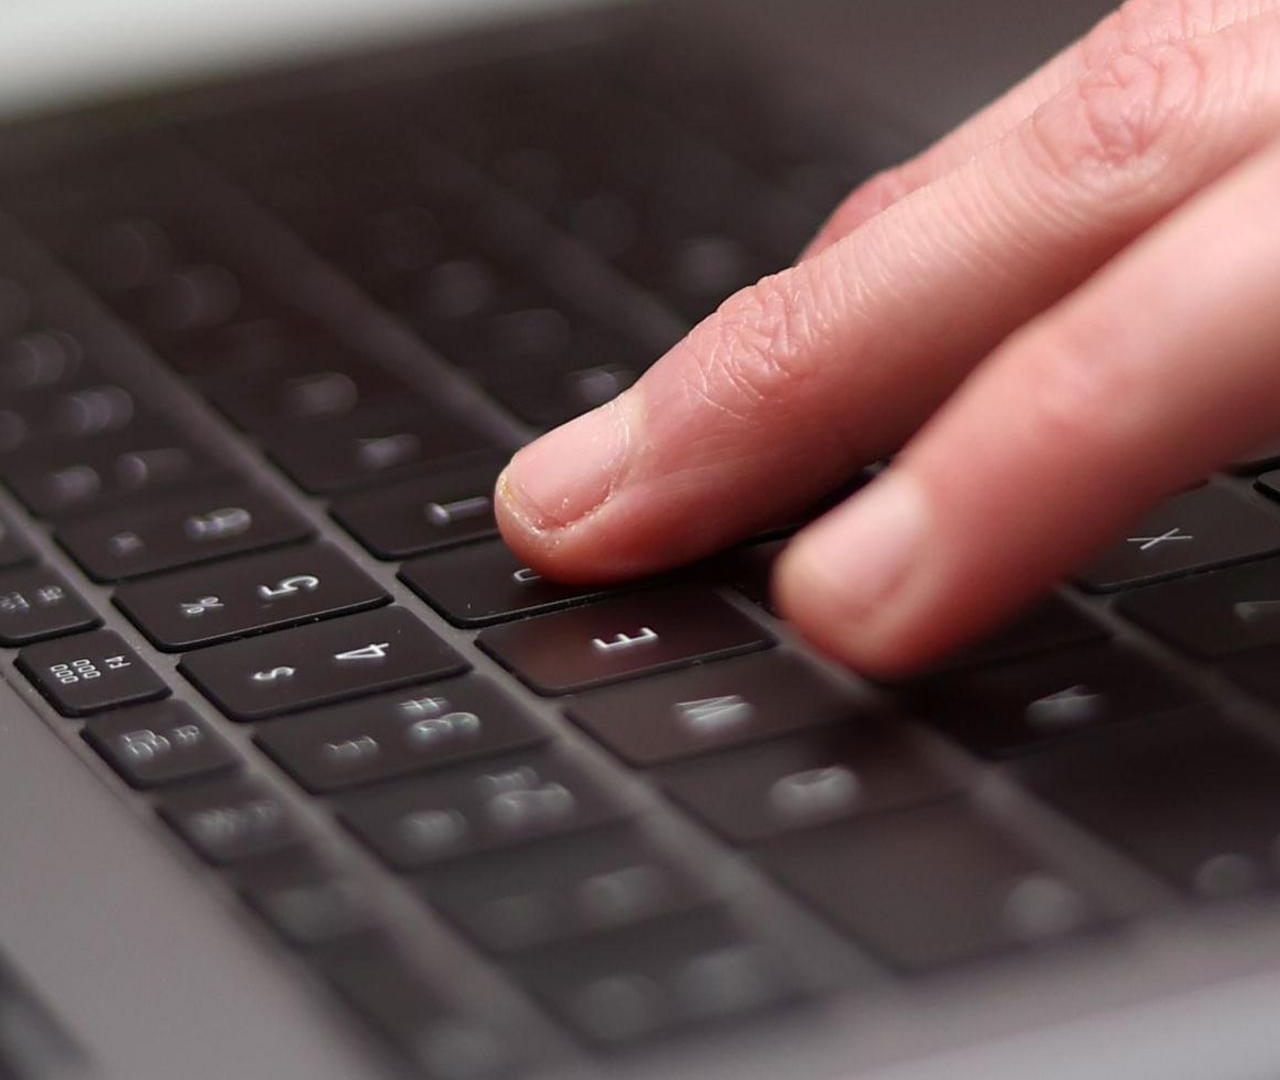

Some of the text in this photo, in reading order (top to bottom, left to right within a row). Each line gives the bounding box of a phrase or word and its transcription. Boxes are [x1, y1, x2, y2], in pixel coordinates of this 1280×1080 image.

[1126, 527, 1193, 551] X
[259, 575, 320, 599] 5
[180, 596, 225, 615] %
[593, 626, 659, 650] E
[334, 643, 391, 661] 4
